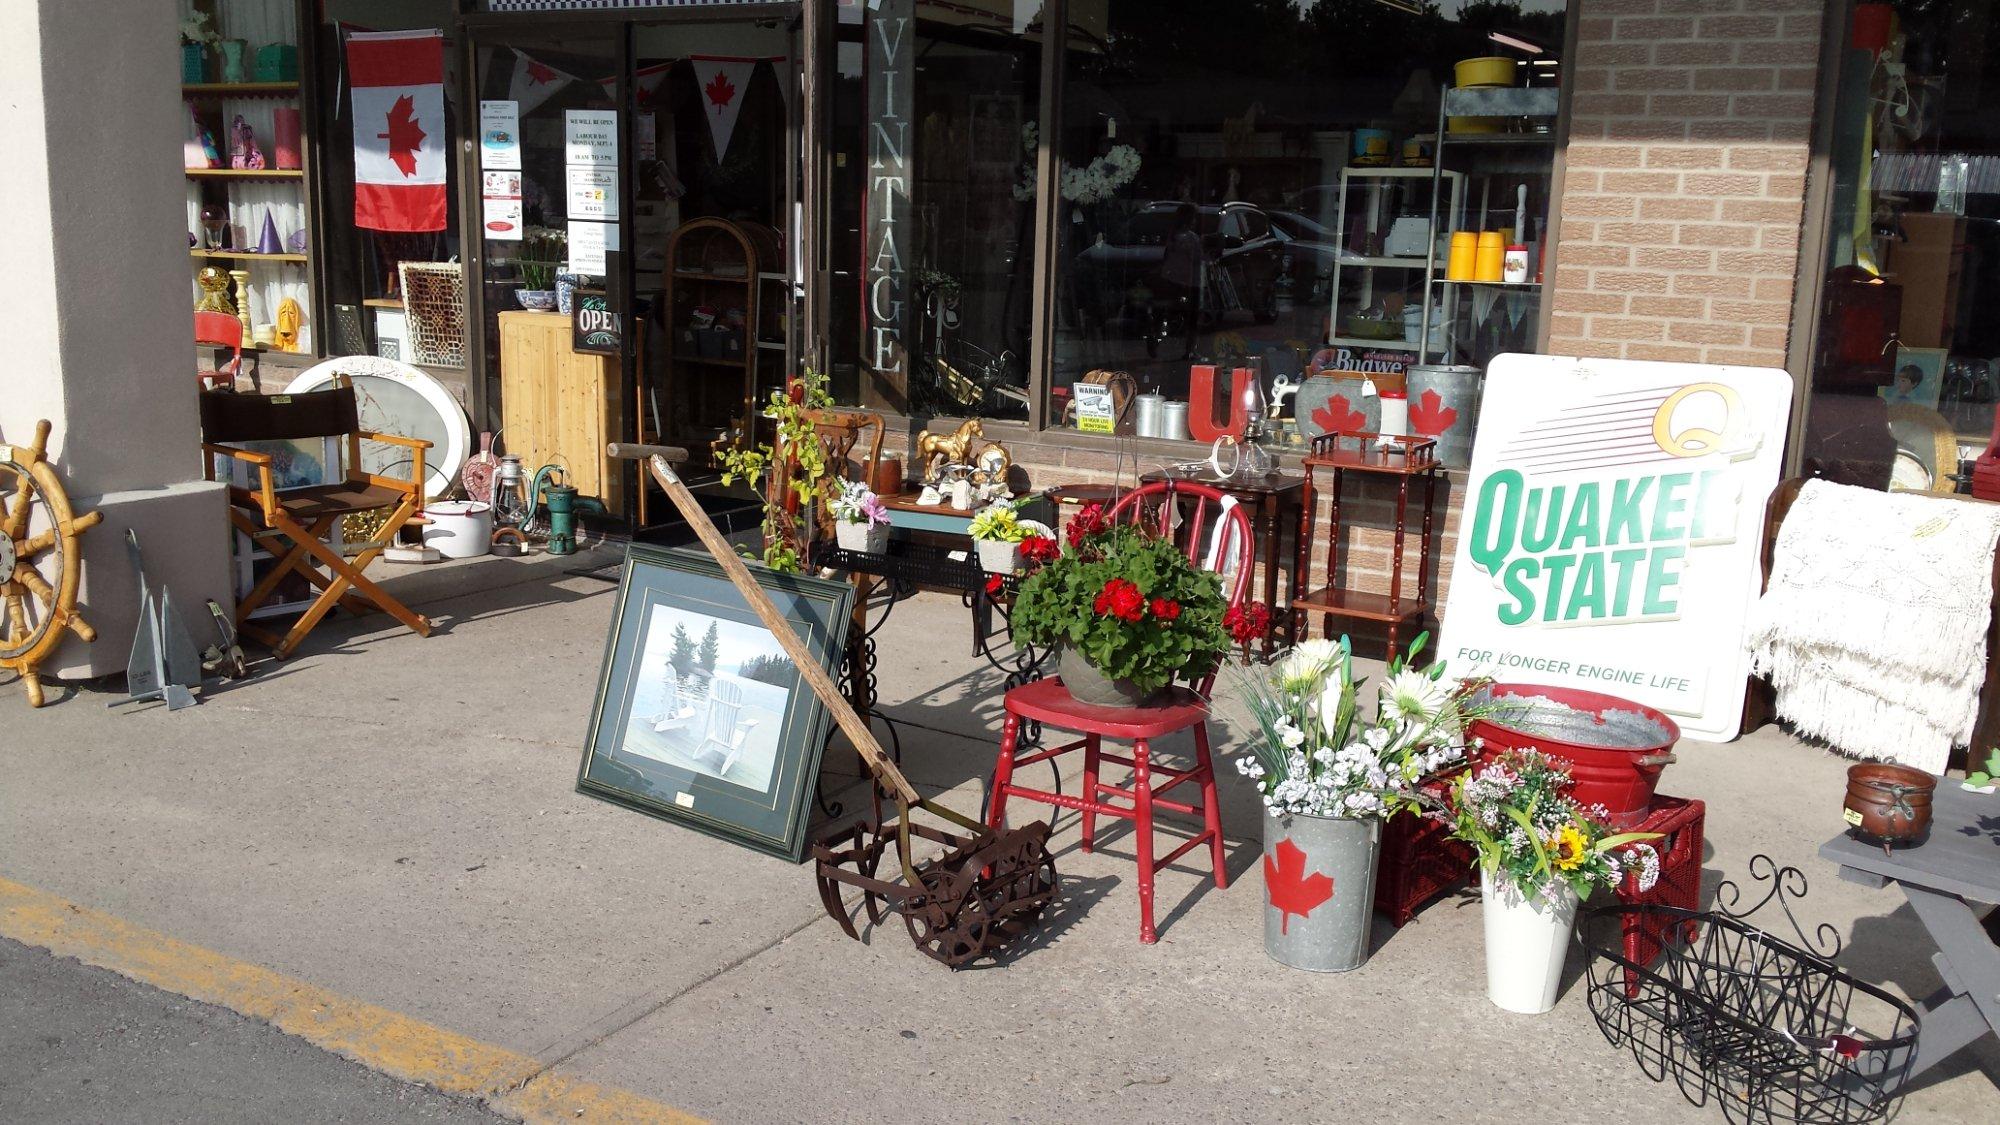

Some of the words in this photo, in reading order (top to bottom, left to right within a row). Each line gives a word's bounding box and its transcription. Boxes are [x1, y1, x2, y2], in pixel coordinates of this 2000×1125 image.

[871, 18, 908, 372] VINTAGE
[580, 309, 622, 335] OPEN
[1078, 387, 1109, 395] WARNING
[1498, 546, 1685, 625] STATE
[1457, 647, 1493, 663] FOR
[1498, 653, 1570, 674] LONGER
[1576, 664, 1645, 685] ENGINE
[1650, 674, 1691, 692] LIFE
